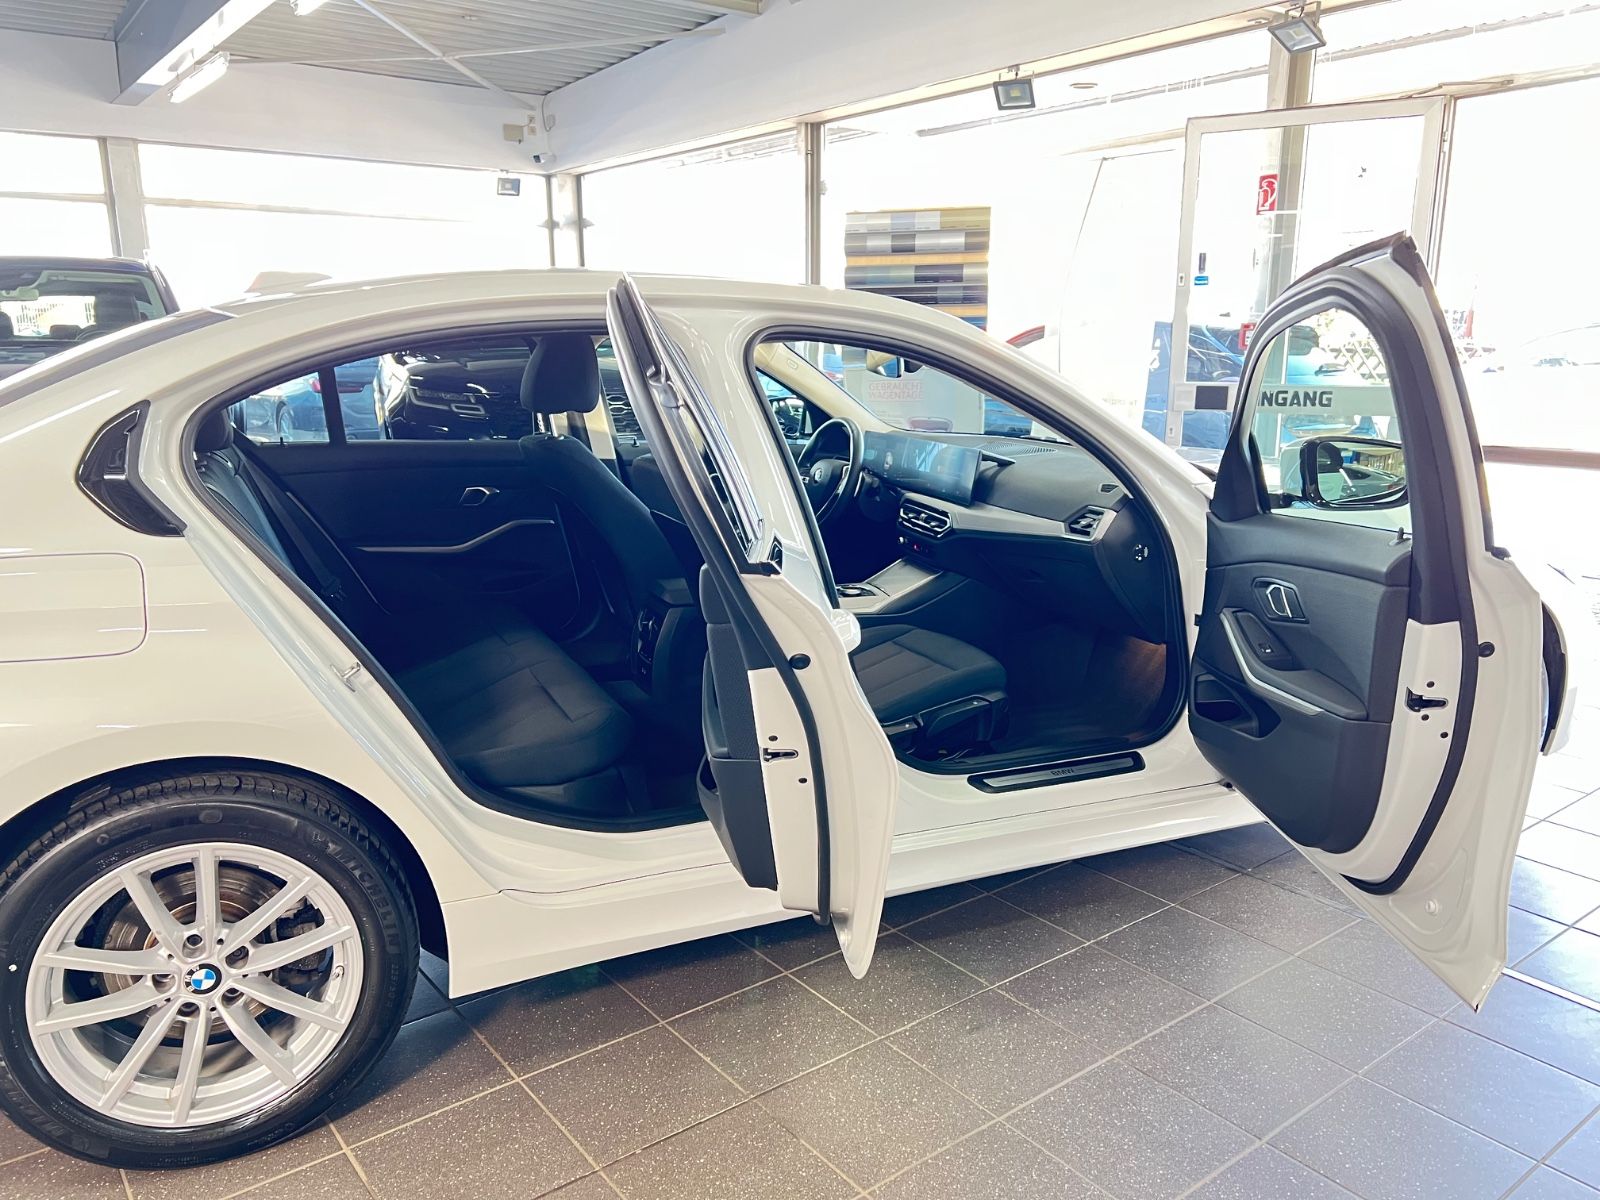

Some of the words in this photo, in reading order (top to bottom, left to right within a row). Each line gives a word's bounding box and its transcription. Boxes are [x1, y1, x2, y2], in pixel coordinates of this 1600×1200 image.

[1258, 390, 1333, 407] NGANG
[1050, 768, 1074, 776] BMW
[331, 845, 401, 948] MICHELIN
